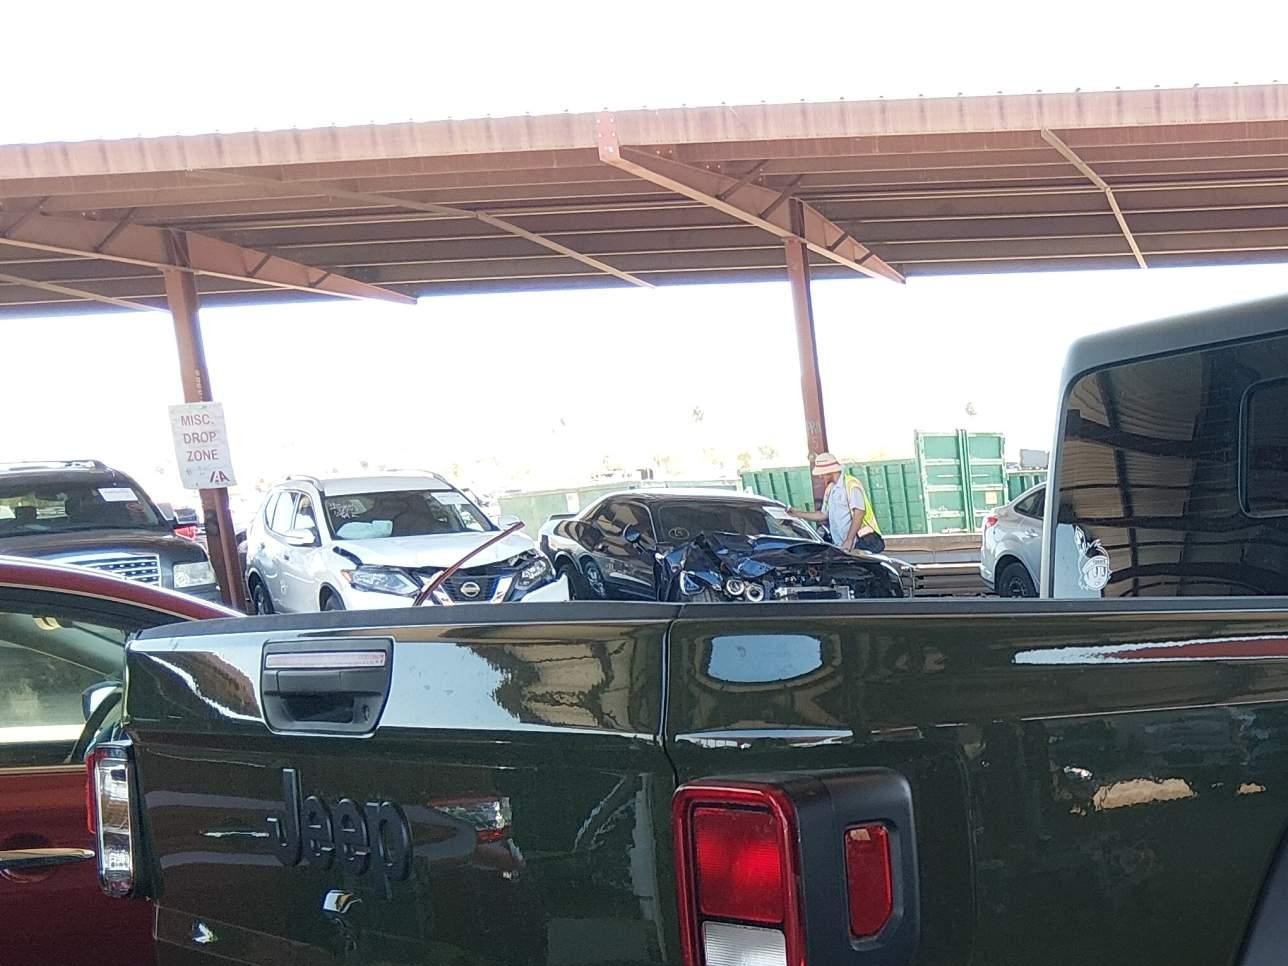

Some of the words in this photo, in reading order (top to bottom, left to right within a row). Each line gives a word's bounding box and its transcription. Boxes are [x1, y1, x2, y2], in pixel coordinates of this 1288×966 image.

[181, 413, 214, 426] MISC.
[183, 431, 217, 444] DROP
[186, 449, 219, 462] ZONE
[266, 768, 413, 898] Jeep
